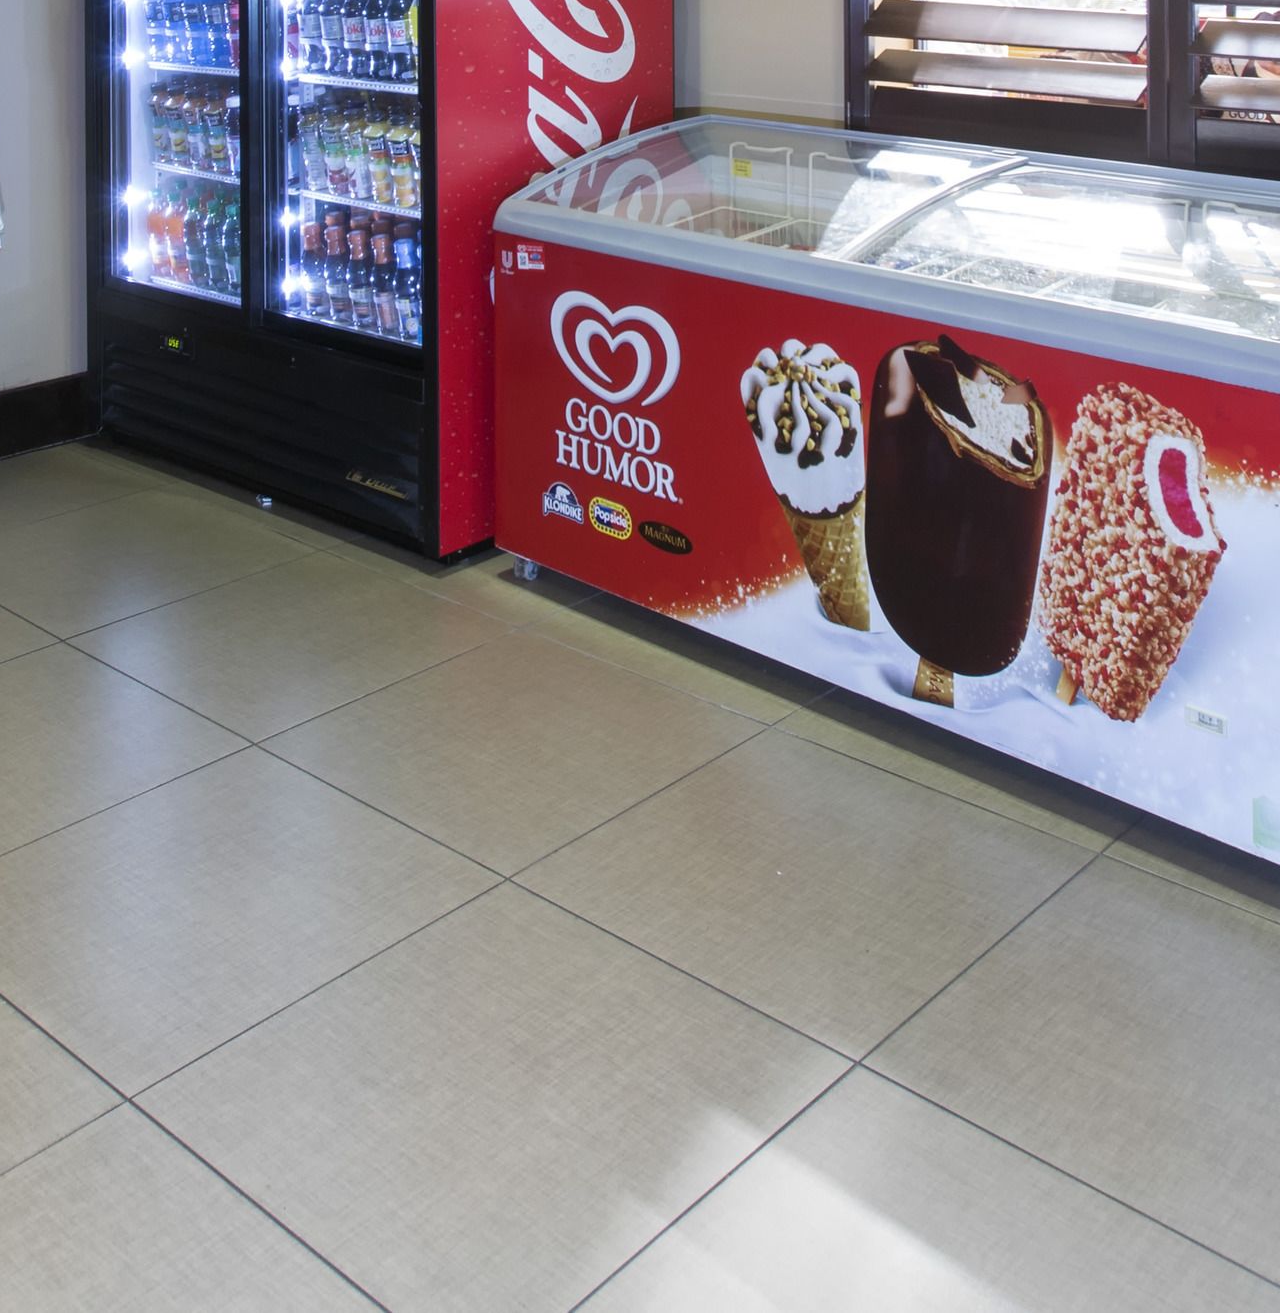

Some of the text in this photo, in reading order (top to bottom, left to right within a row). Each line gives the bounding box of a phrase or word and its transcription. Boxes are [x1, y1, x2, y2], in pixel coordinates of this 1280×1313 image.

[565, 398, 660, 455] GOOD
[555, 429, 678, 503] HUMOR
[543, 493, 583, 523] KLONDIKE
[594, 506, 628, 530] Popsicle
[644, 525, 687, 550] MAGNUM
